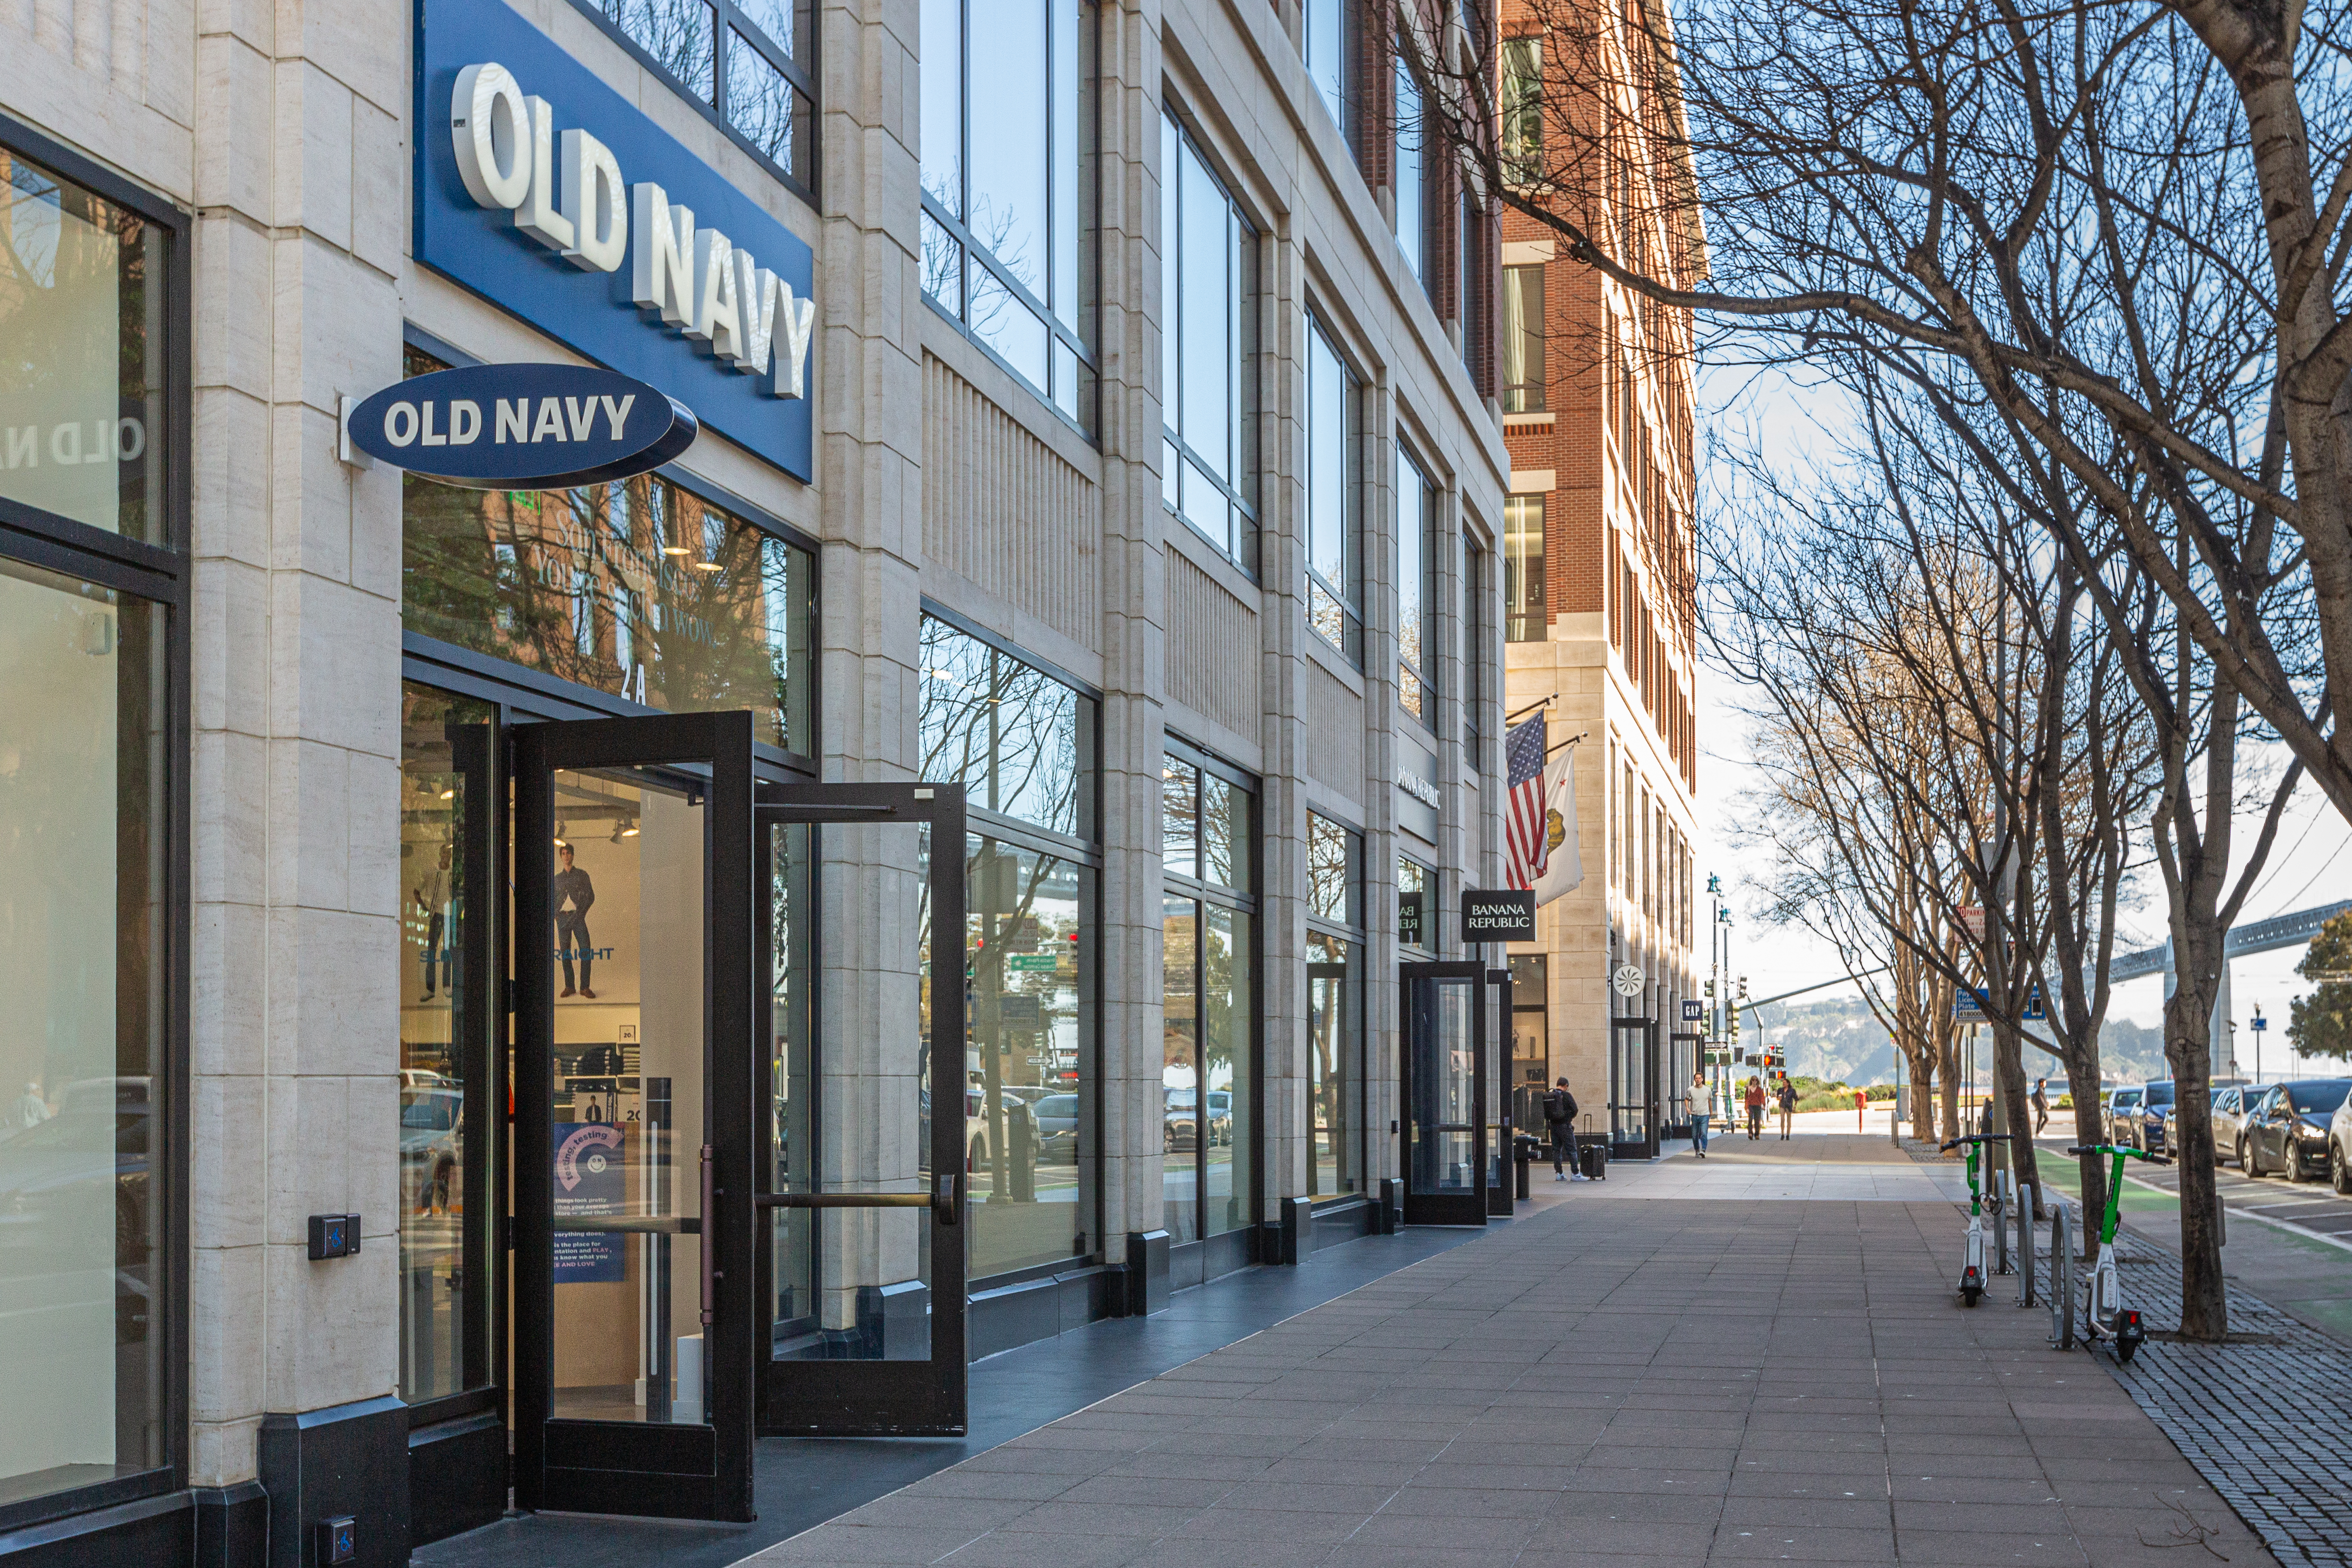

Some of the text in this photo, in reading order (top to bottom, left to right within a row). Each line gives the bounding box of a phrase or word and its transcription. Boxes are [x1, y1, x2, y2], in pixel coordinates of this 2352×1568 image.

[452, 62, 815, 399] OLD NAVY
[384, 394, 635, 447] OLD NAVY
[556, 510, 596, 560] San
[1472, 905, 1526, 915] BANANA
[1469, 917, 1530, 928] REPUBLIC
[1686, 1005, 1700, 1017] GAP
[573, 1131, 608, 1146] testing
